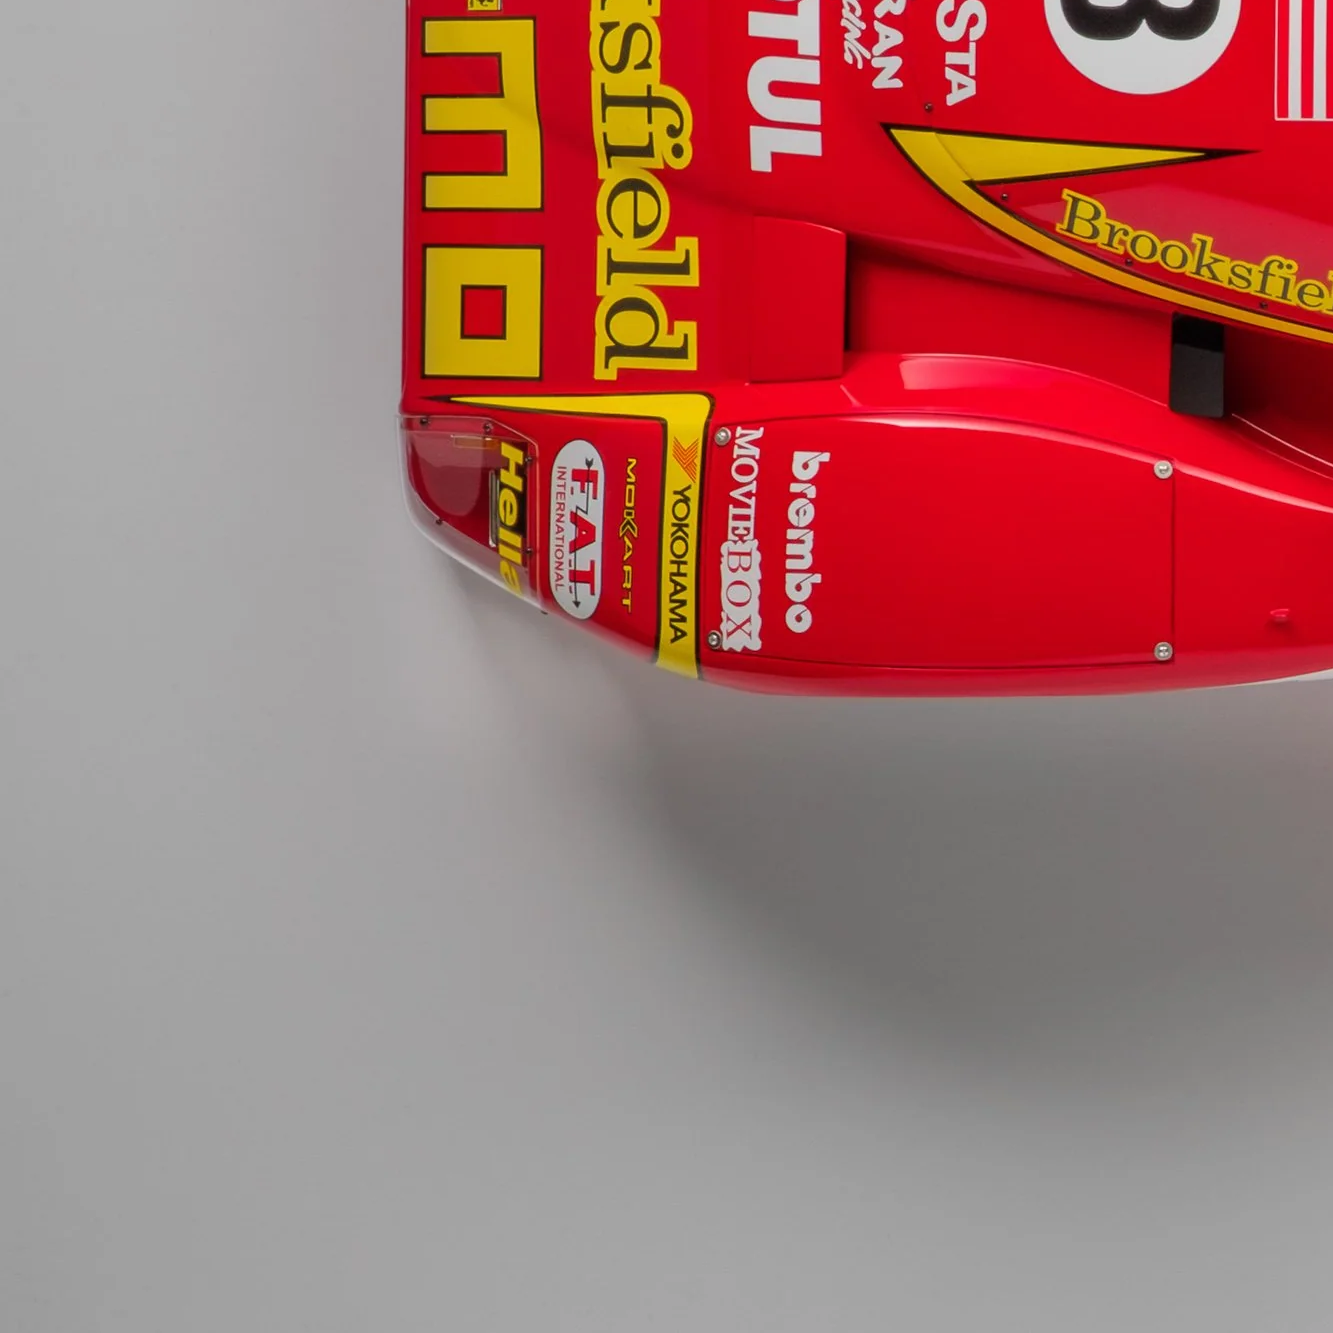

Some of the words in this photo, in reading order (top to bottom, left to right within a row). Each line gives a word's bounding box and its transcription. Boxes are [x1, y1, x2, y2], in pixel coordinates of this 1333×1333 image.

[498, 441, 525, 597] Hella
[554, 465, 567, 592] INTERNATIONAL
[619, 457, 638, 613] MOKART
[669, 484, 693, 644] YOKOHAMA
[785, 450, 831, 633] brembo
